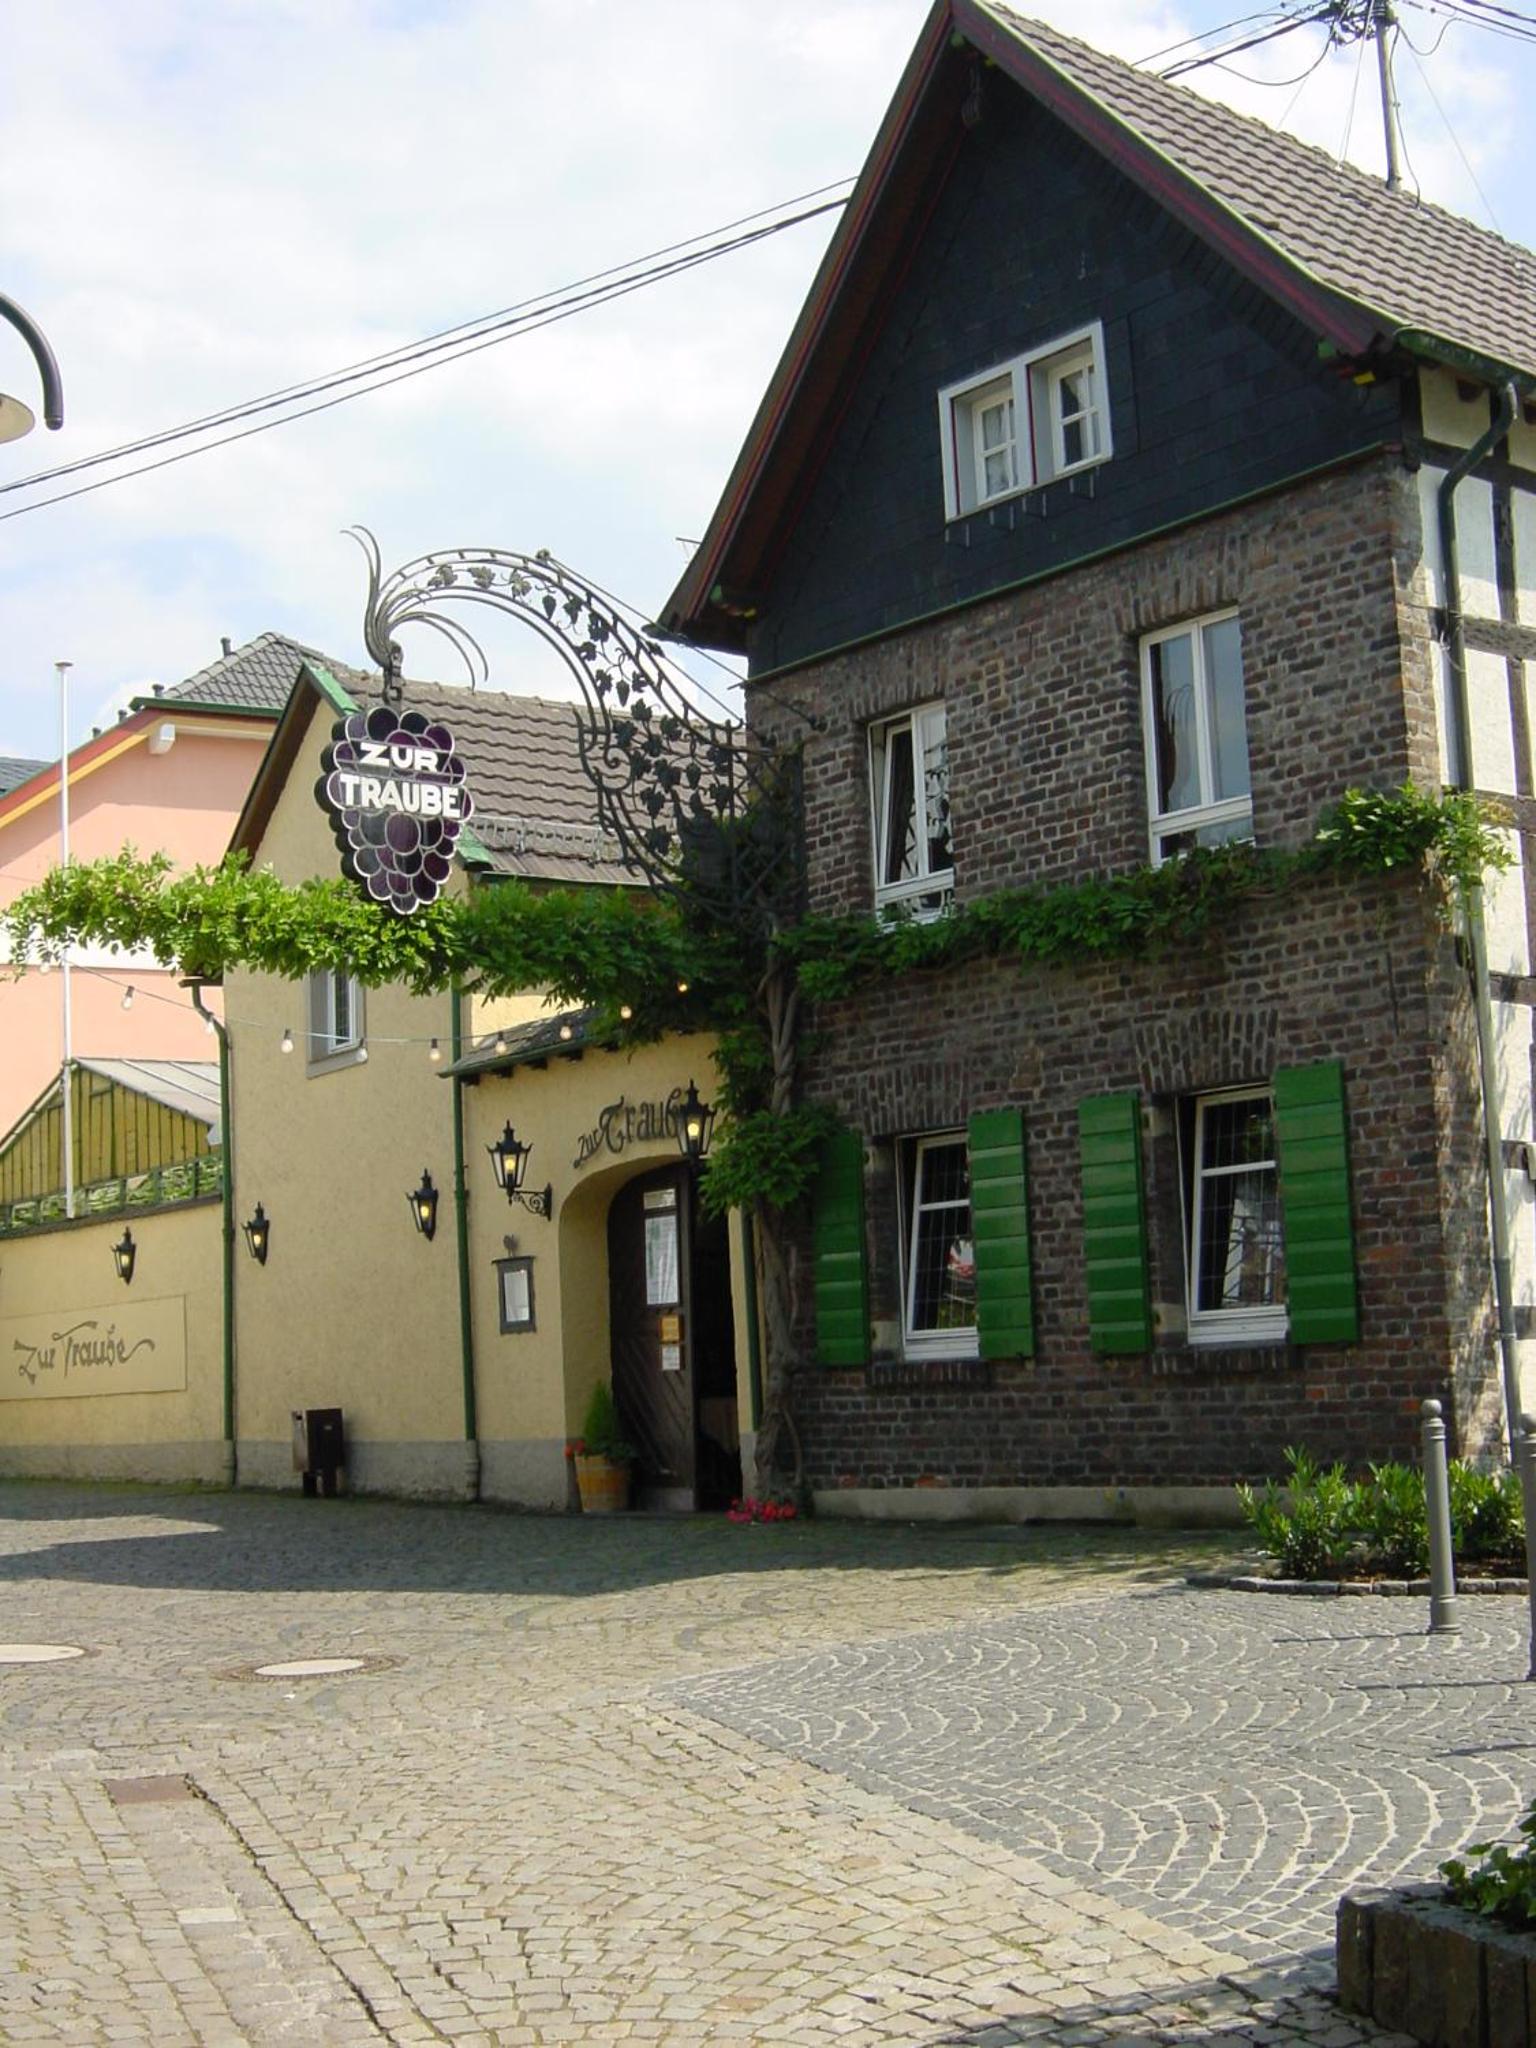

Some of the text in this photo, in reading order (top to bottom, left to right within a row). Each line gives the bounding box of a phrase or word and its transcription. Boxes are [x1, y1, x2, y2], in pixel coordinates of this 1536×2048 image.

[359, 742, 438, 773] ZUR
[339, 773, 461, 818] TRAUBE
[599, 1087, 682, 1154] Traub
[13, 1320, 156, 1385] Zur Traube
